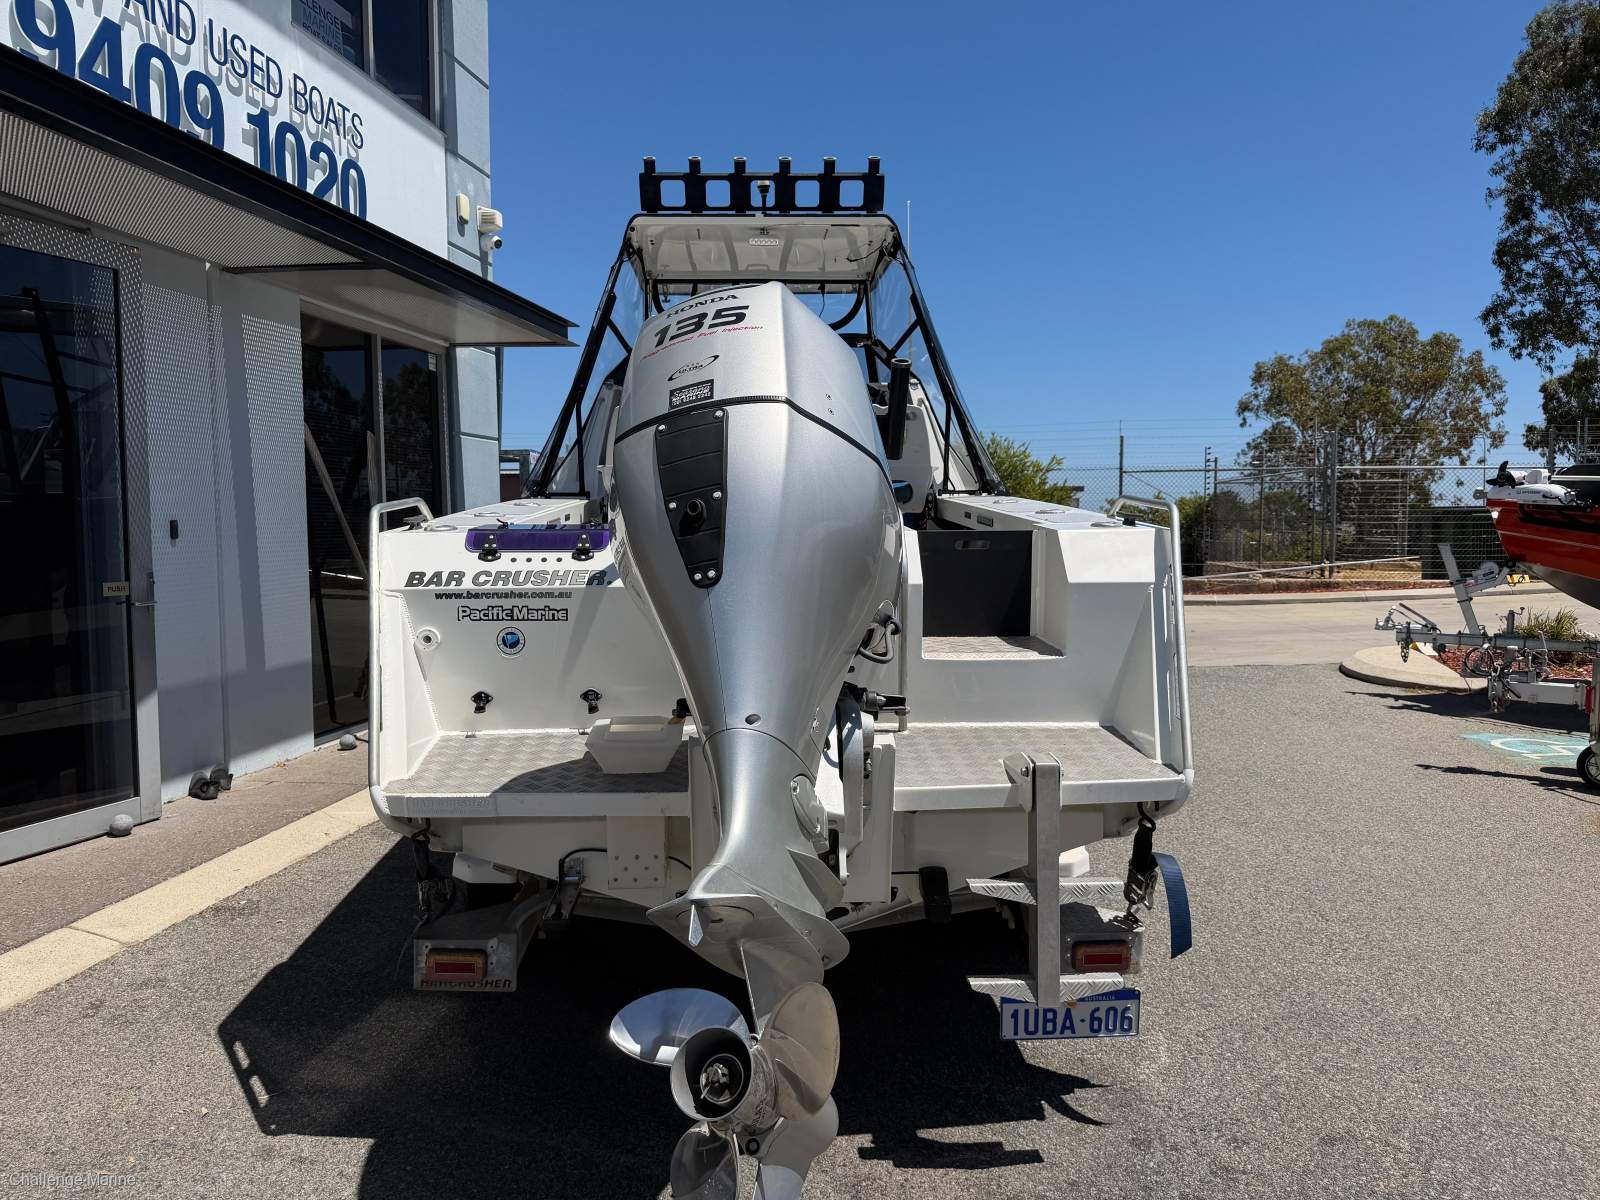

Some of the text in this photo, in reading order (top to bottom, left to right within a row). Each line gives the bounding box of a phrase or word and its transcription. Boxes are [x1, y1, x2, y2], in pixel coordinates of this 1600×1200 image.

[303, 8, 342, 46] MARINE
[209, 18, 283, 99] USED
[293, 73, 364, 150] BOATS
[15, 0, 368, 221] 9409 1020
[666, 294, 740, 318] HONDA
[654, 305, 750, 348] 135
[404, 569, 607, 588] BAR CRUSHER
[434, 590, 573, 600] www.barcrusher.com.au
